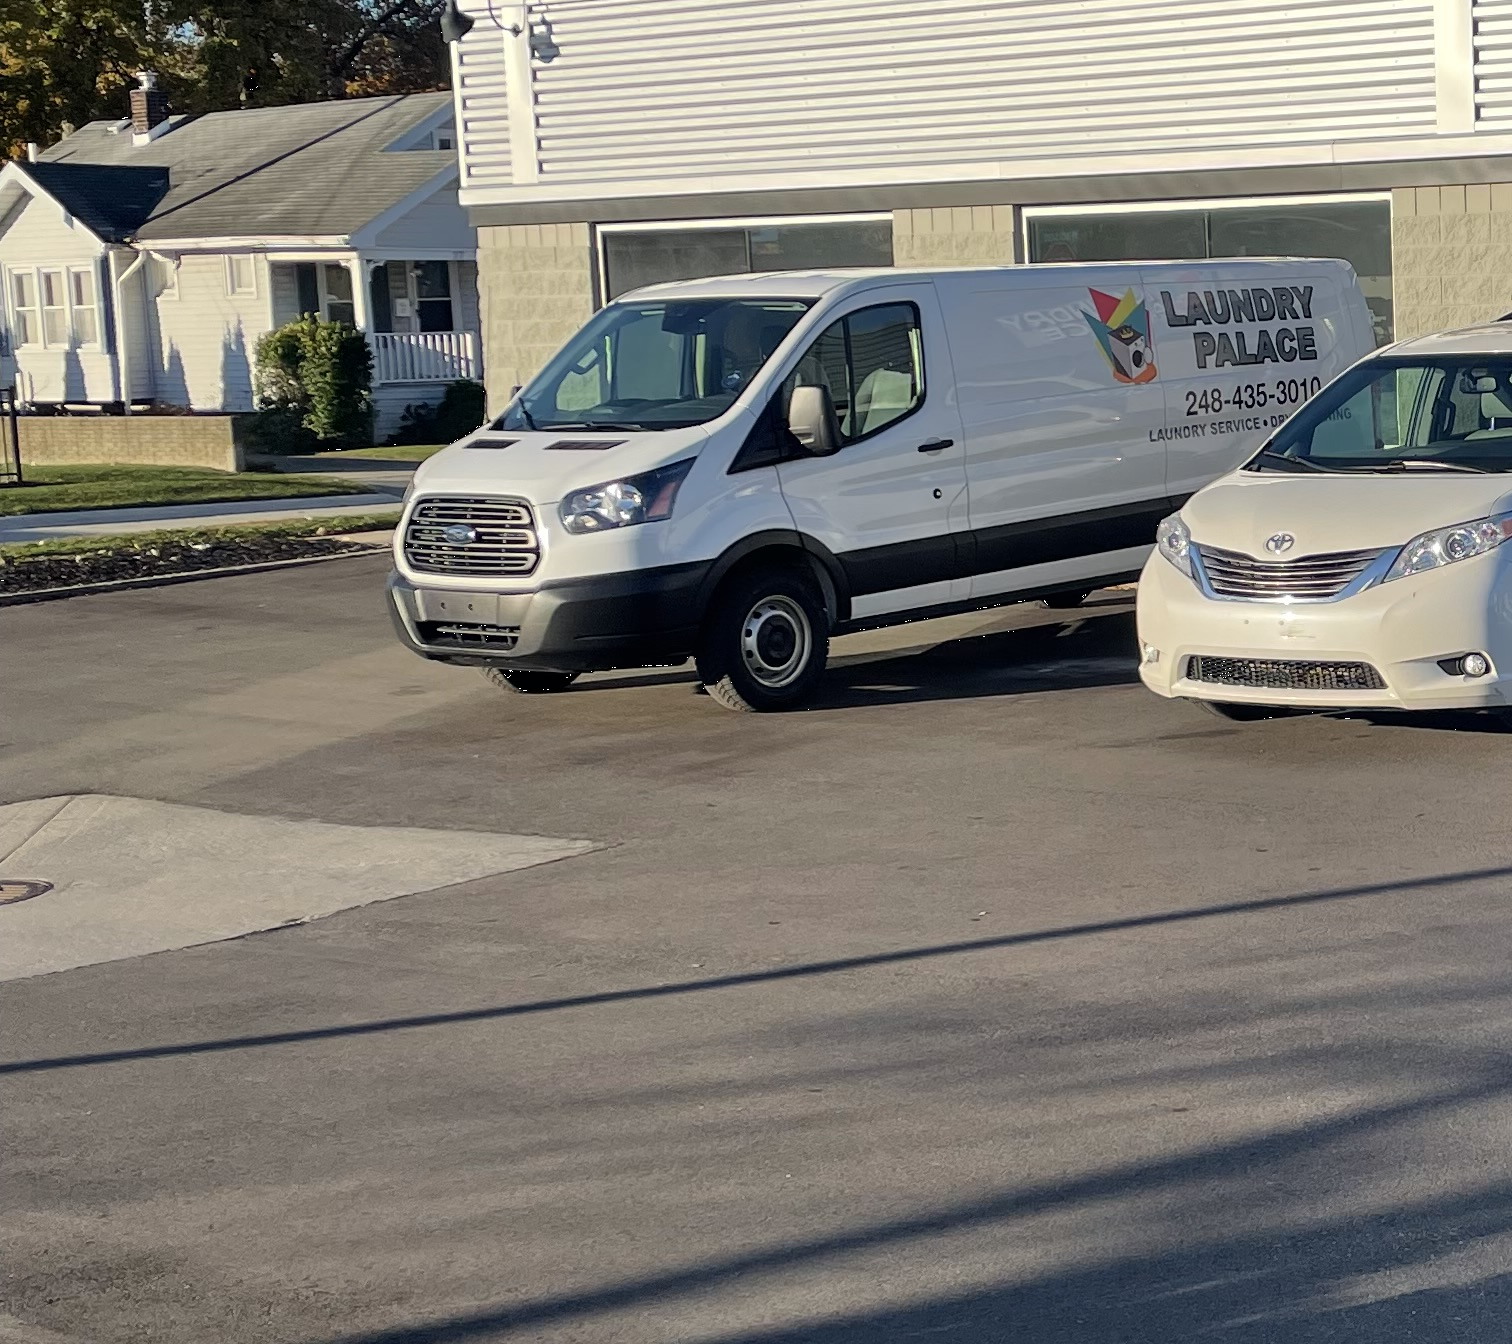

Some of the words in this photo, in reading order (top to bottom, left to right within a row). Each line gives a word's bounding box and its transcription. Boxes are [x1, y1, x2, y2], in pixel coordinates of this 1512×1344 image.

[1160, 286, 1313, 327] LAUNDRY
[1193, 327, 1318, 369] PALACE
[1185, 376, 1321, 417] 248-435-3010
[1149, 424, 1206, 442] LAUNDRY
[1210, 417, 1261, 435] SERVICE
